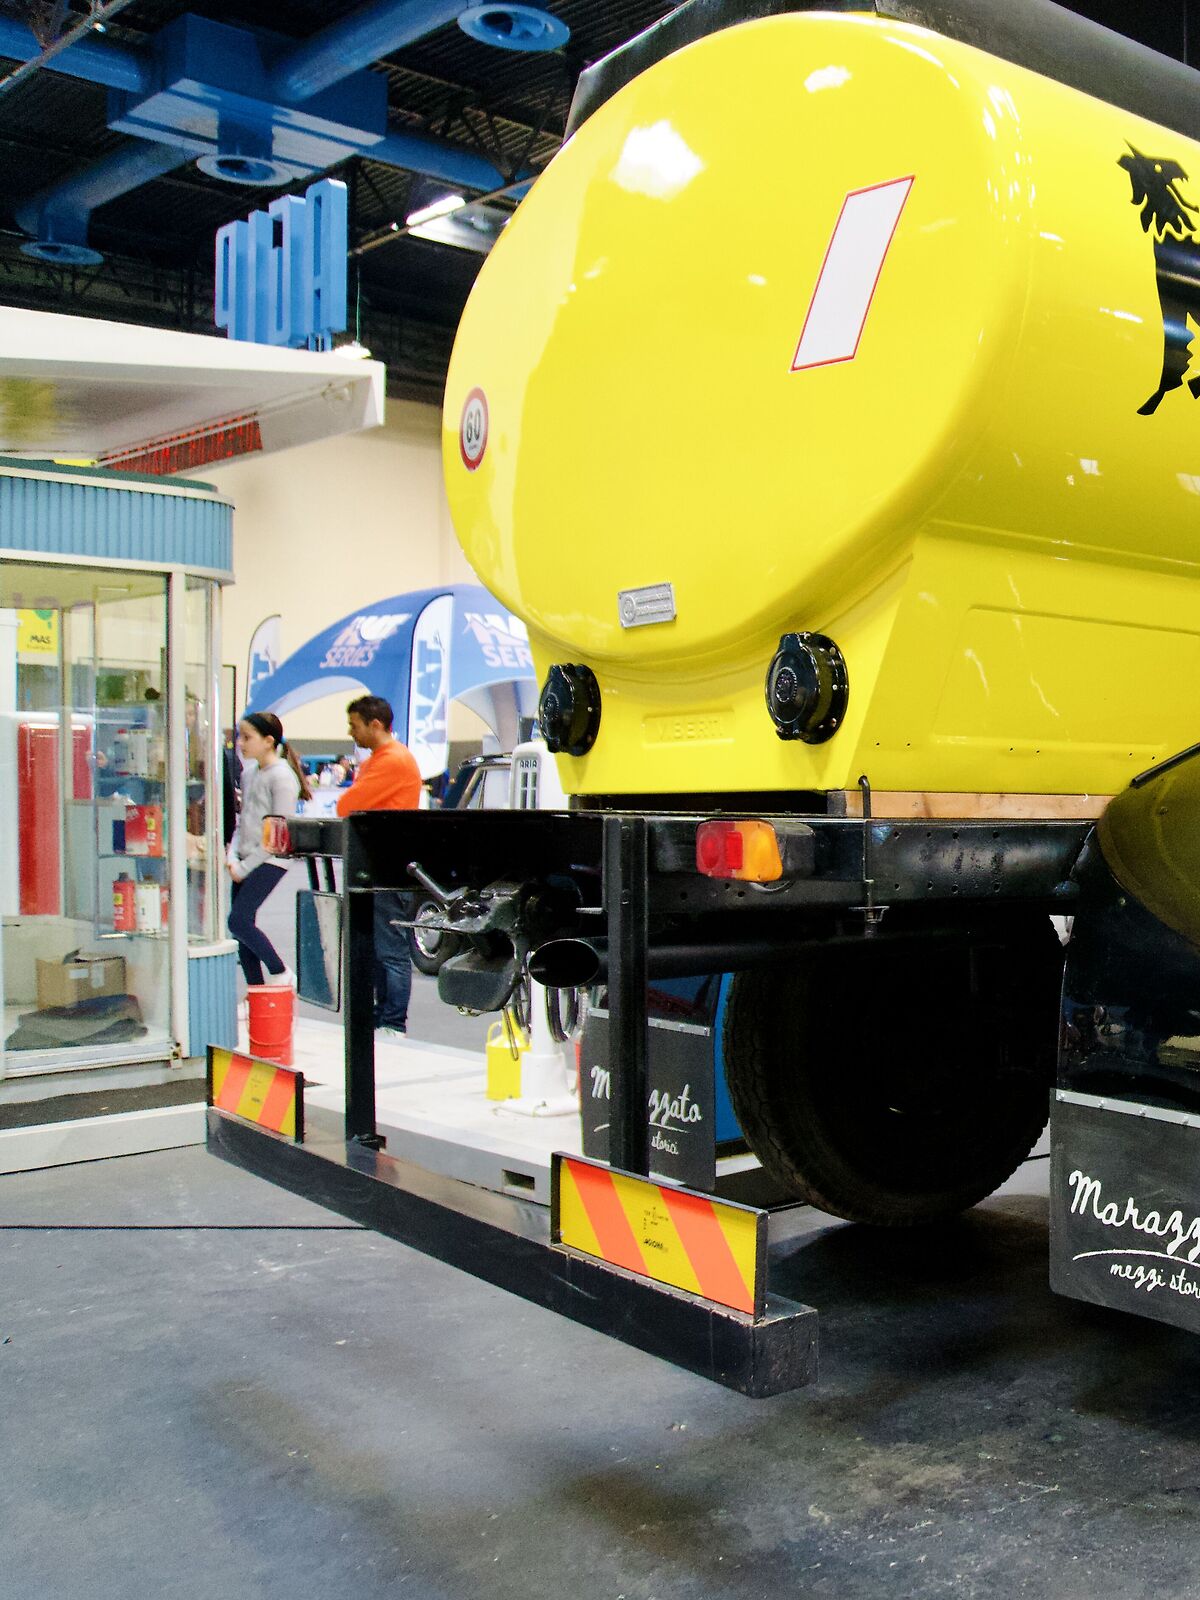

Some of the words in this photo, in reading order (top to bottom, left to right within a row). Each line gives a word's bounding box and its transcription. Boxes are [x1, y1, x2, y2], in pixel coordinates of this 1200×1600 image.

[466, 407, 481, 443] 60
[481, 645, 534, 668] SER
[520, 760, 537, 768] ARIA
[590, 1065, 702, 1126] Mzzato
[1110, 1263, 1166, 1292] mezzi
